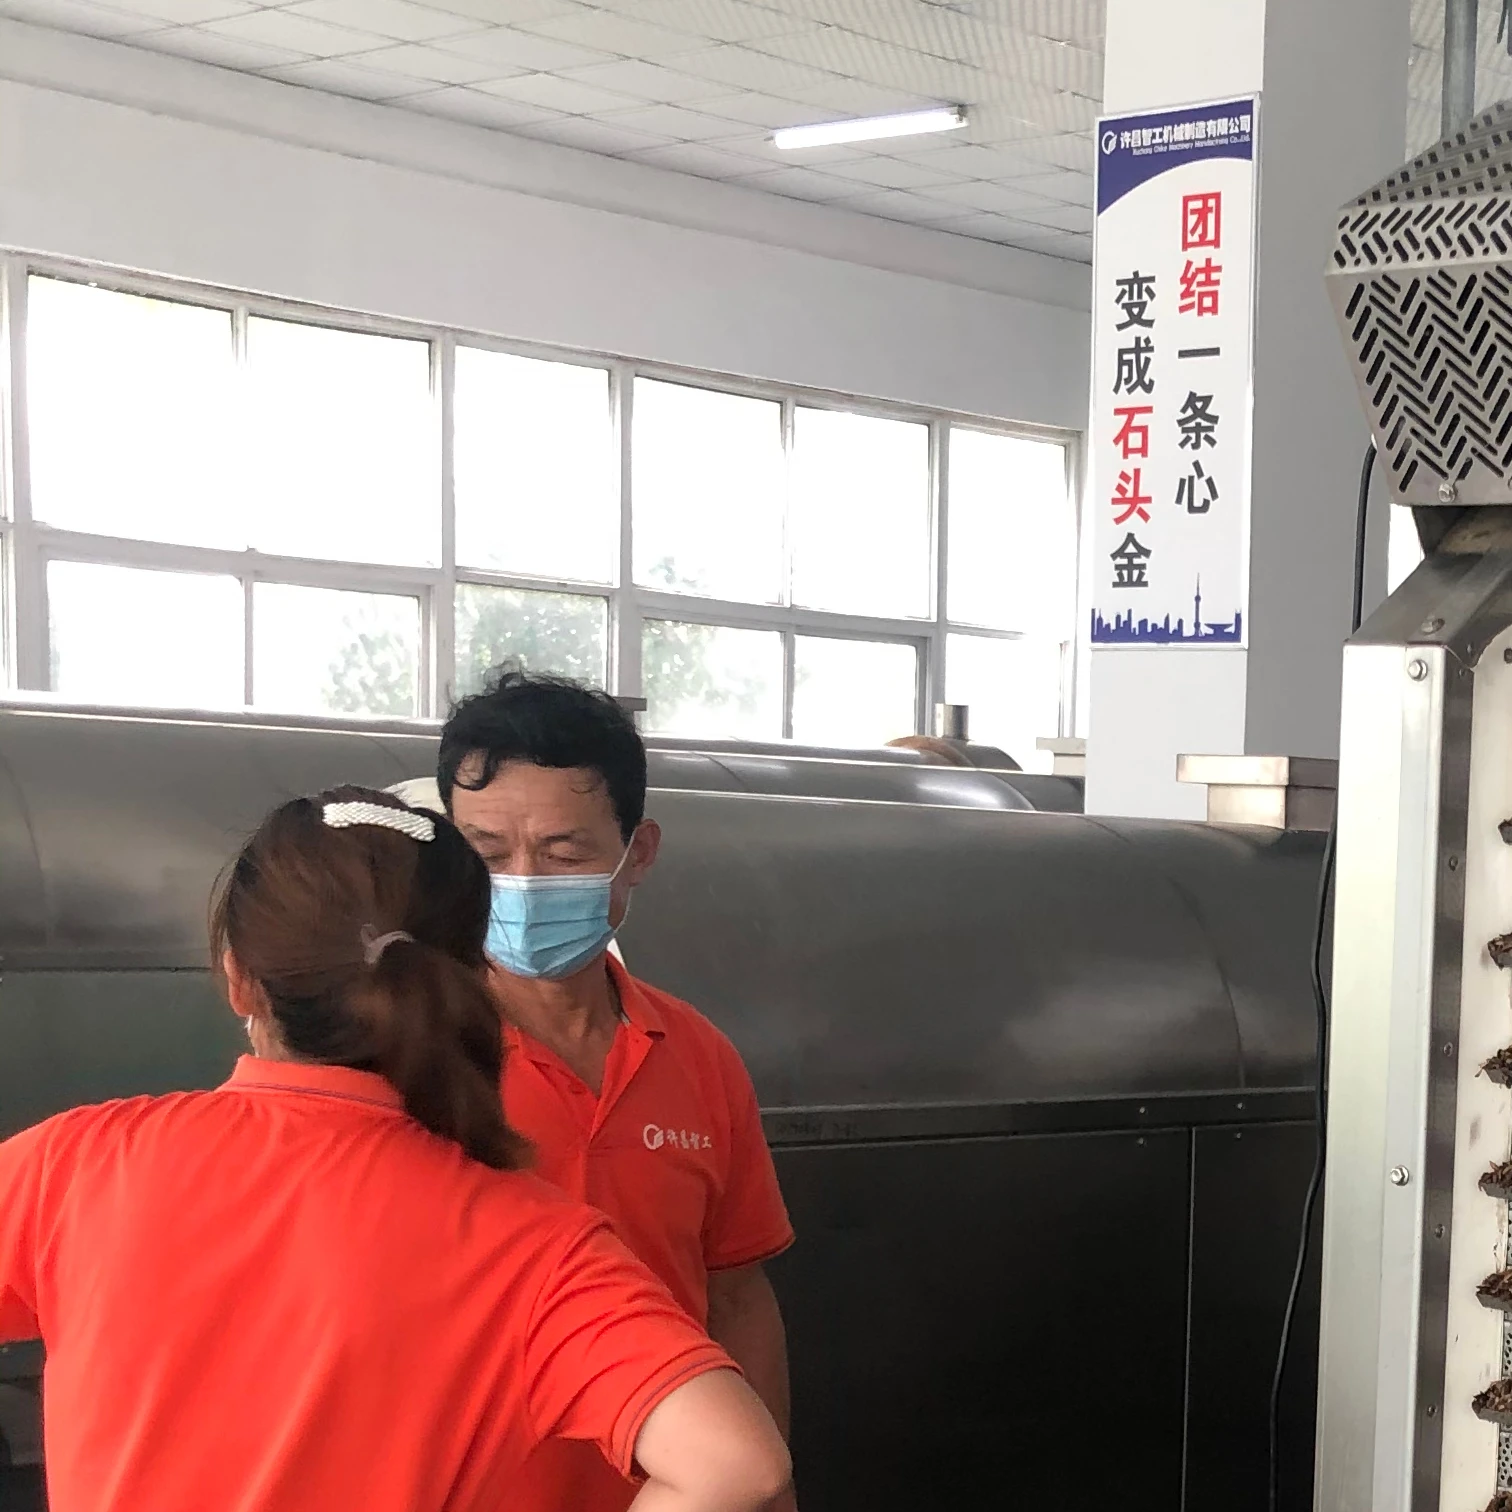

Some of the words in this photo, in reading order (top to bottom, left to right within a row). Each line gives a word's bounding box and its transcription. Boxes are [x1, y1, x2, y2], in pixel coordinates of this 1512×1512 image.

[1110, 270, 1157, 588] 变成石头金
[1175, 191, 1223, 514] 团结一条心
